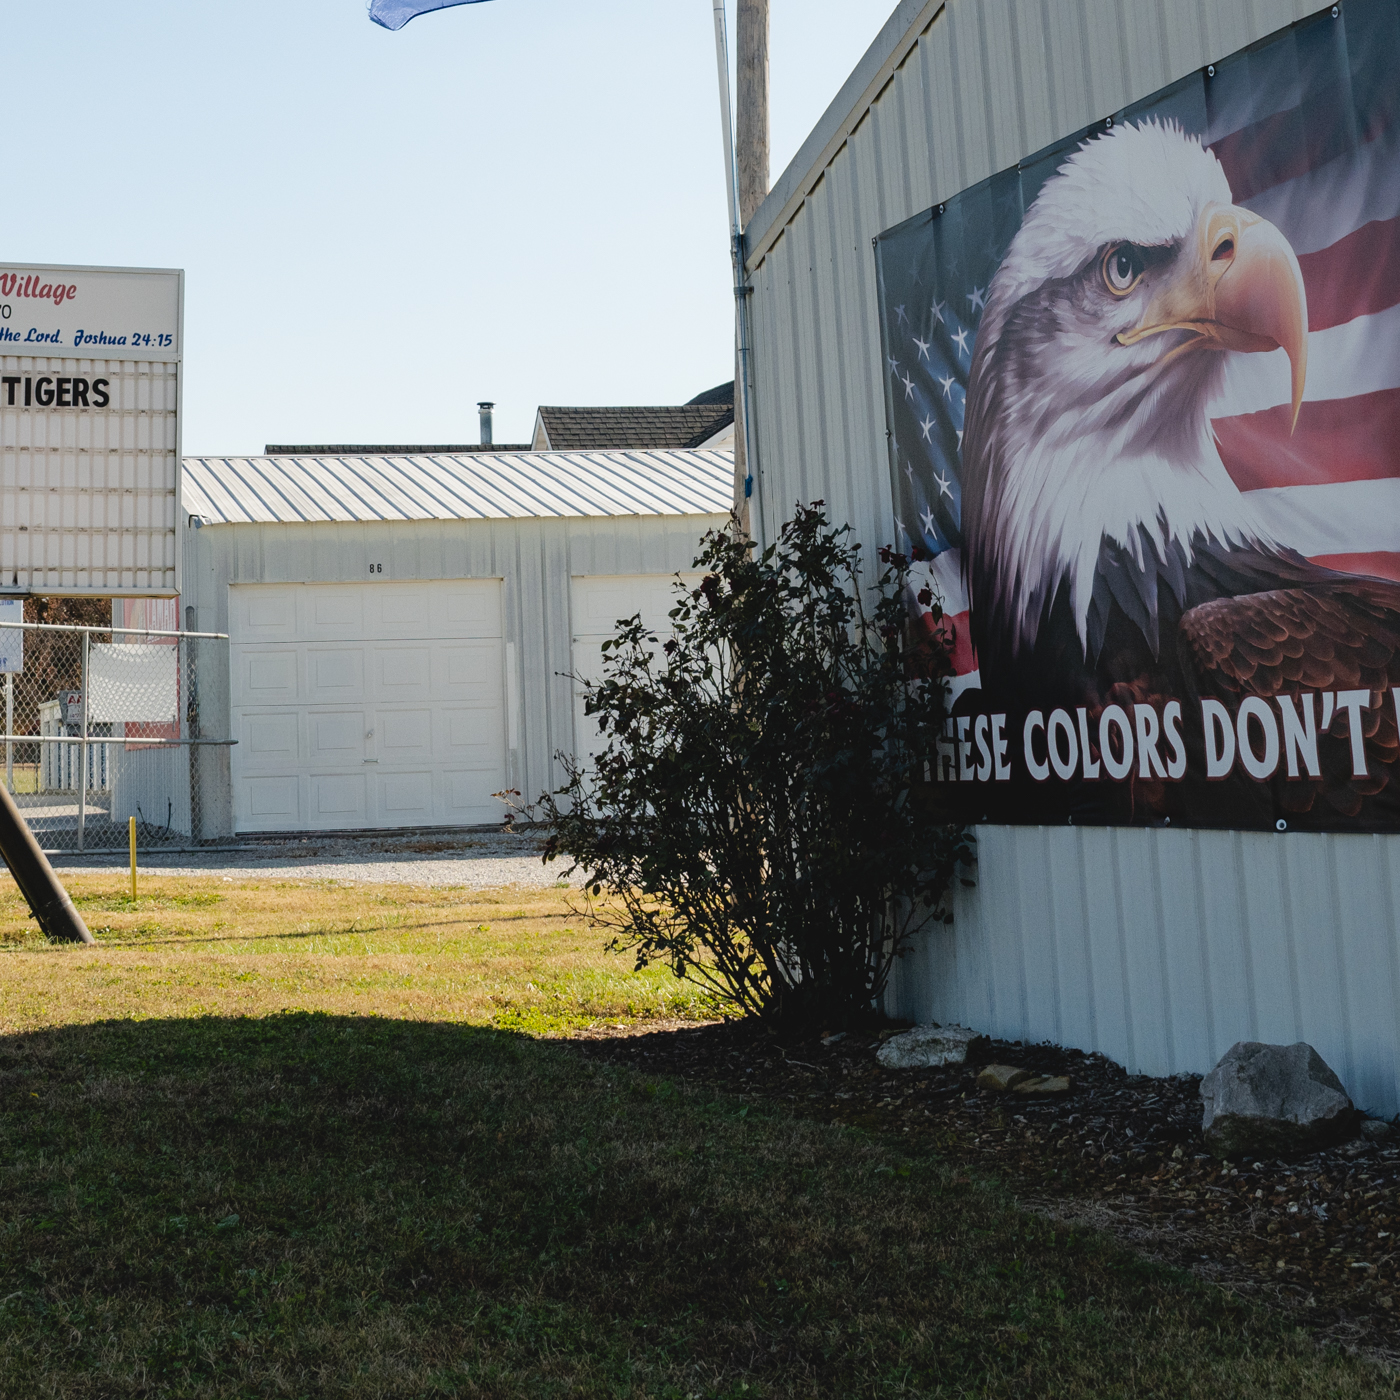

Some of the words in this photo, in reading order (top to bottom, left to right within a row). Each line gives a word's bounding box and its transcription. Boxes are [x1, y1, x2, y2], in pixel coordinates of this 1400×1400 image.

[0, 272, 77, 305] Village
[24, 327, 63, 344] Lord.
[74, 330, 127, 347] Joshua
[131, 332, 173, 347] 24:15
[2, 376, 110, 407] TIGERS
[369, 563, 382, 573] 86
[1023, 700, 1187, 782] COLORS
[1202, 689, 1372, 780] DON'T
